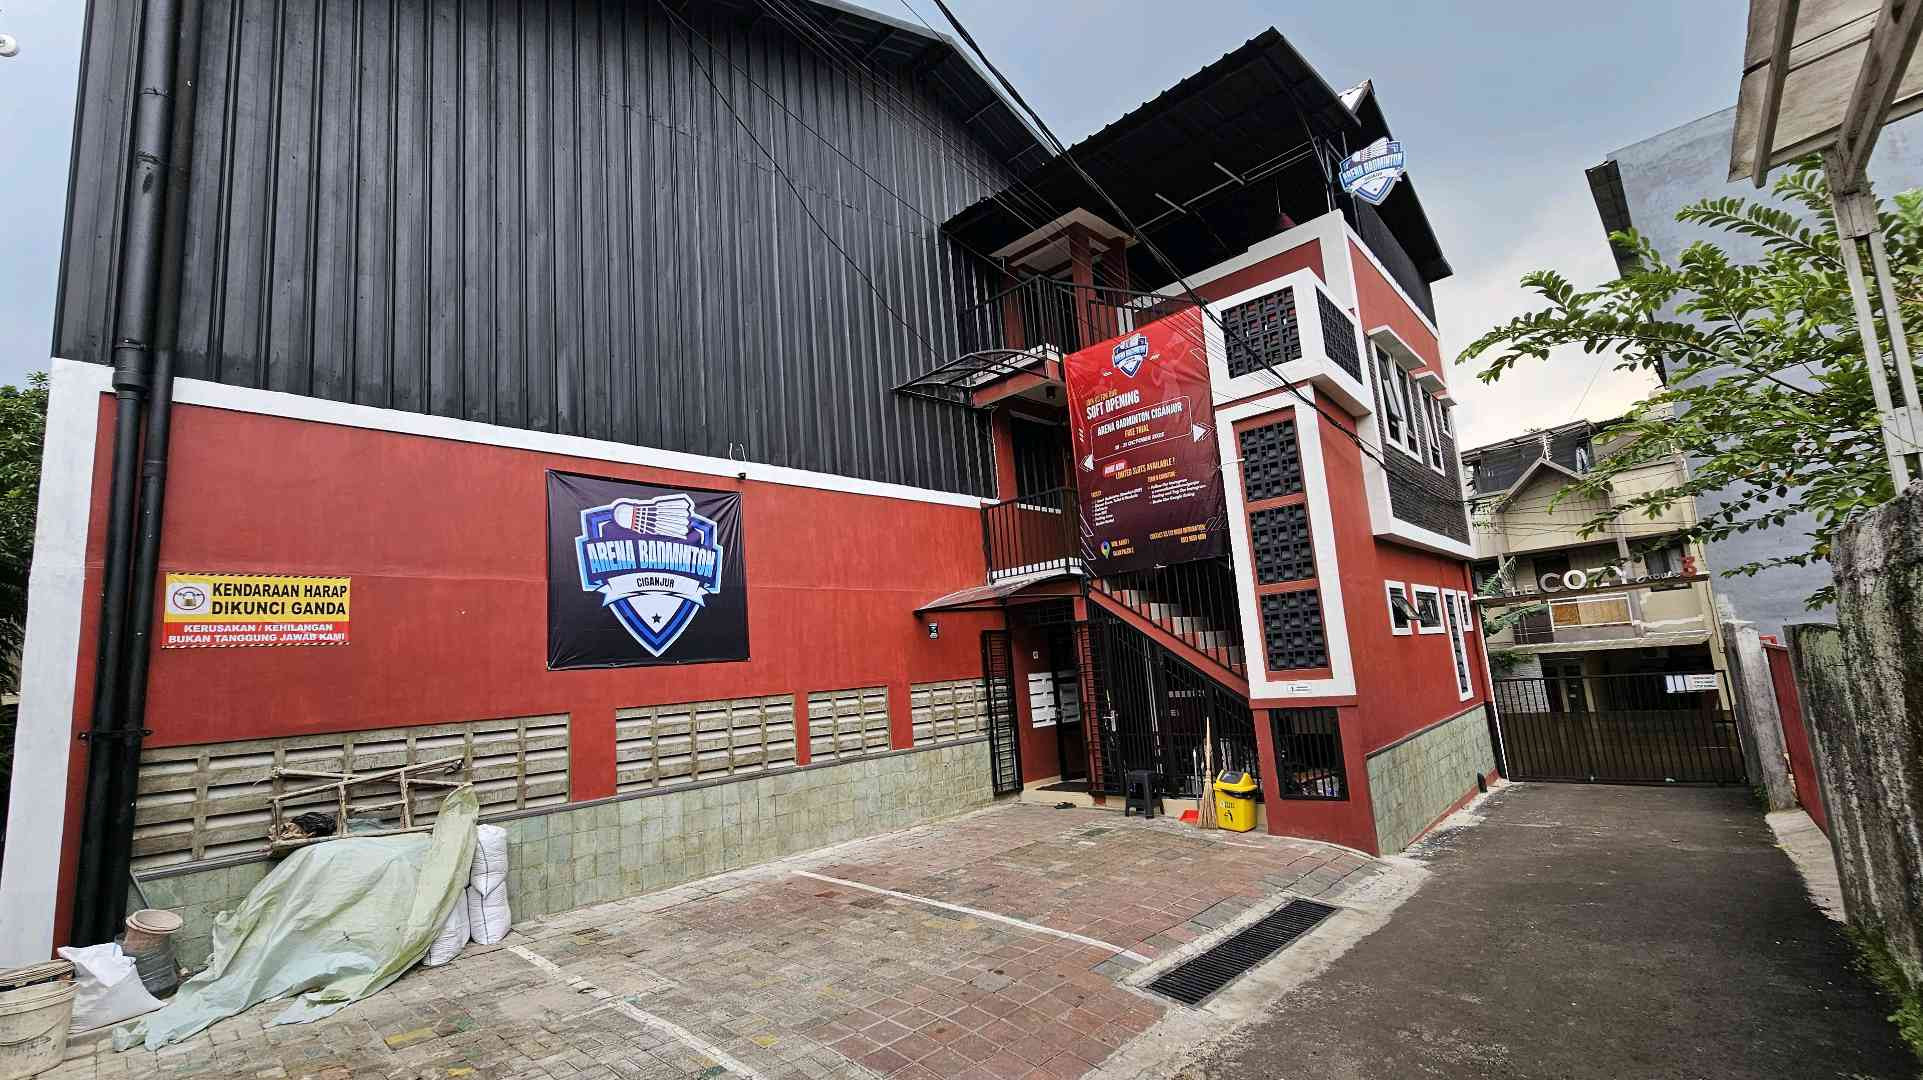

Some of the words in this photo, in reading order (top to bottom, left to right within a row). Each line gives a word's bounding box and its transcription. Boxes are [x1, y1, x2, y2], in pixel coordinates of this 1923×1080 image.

[1087, 402, 1104, 419] SOFT
[1105, 390, 1140, 413] OPENING
[1097, 421, 1115, 436] ARENA
[1116, 410, 1150, 429] BADMINTON
[587, 540, 637, 574] ARENA
[638, 540, 716, 578] BADMINTON
[636, 577, 675, 589] CIGANJUR
[212, 583, 299, 597] KENDARAAN
[303, 584, 347, 598] HARAP
[212, 601, 285, 615] DIKUNCI
[291, 601, 346, 615] GANDA
[184, 624, 255, 633] KERUSAKAN
[264, 623, 333, 632] KEHILANGAN
[168, 635, 210, 643] BUKAN
[214, 633, 277, 642] TANGGUNG
[280, 633, 318, 641] JAWAB
[318, 633, 345, 641] KAMI
